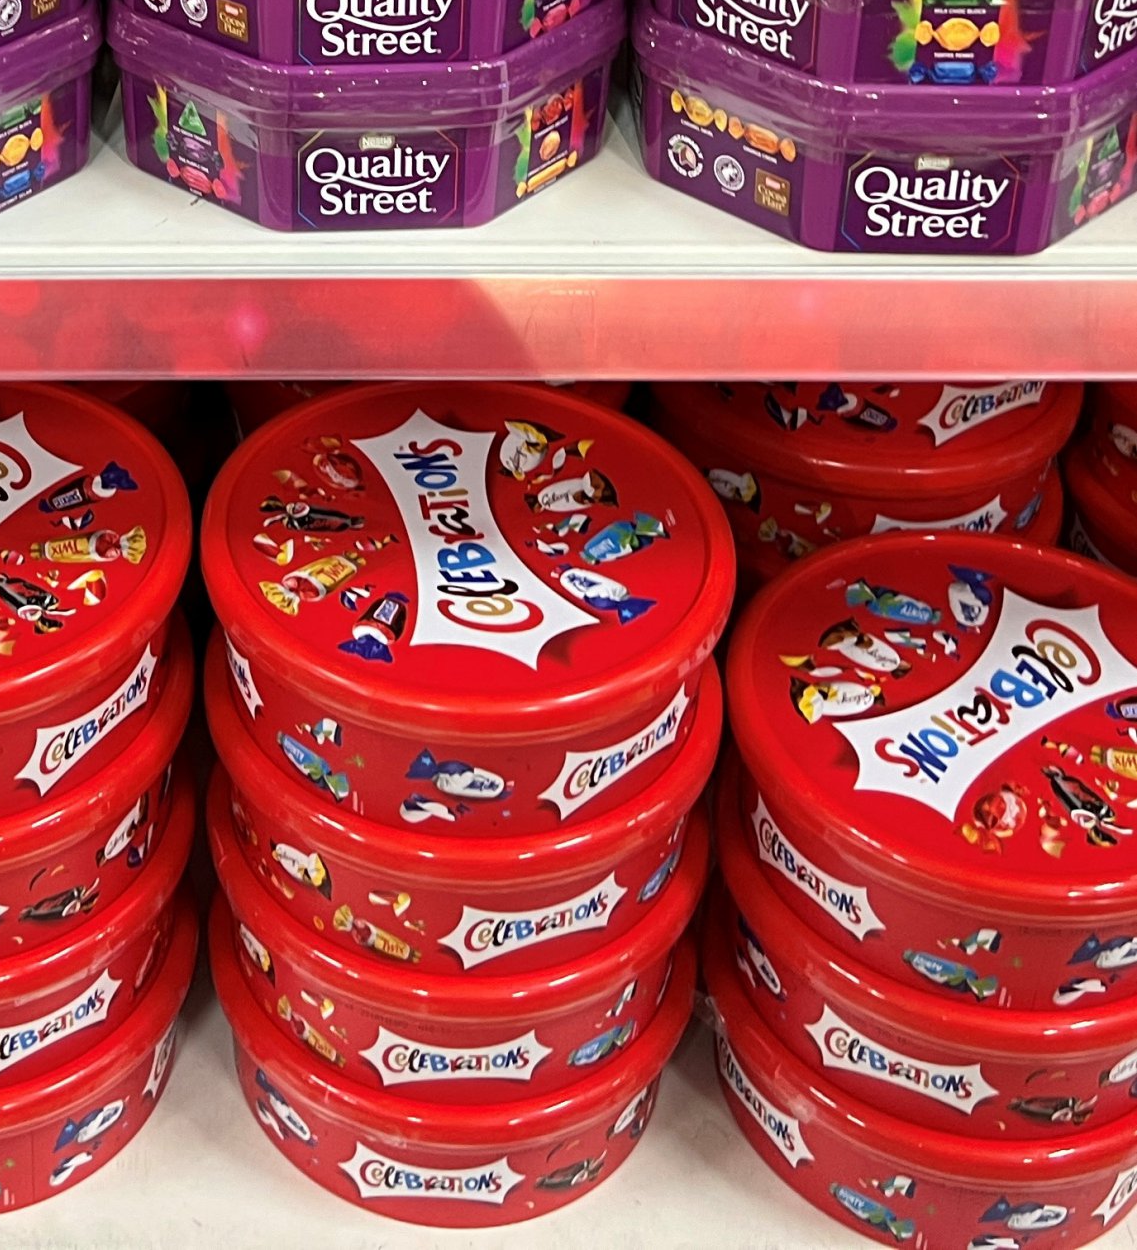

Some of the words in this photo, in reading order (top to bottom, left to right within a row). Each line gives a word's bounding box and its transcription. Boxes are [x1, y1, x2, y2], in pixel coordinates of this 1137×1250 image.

[321, 21, 441, 57] Street
[305, 146, 450, 193] Quality
[319, 183, 437, 217] Street
[855, 165, 1008, 215] Quality
[866, 204, 988, 240] Street
